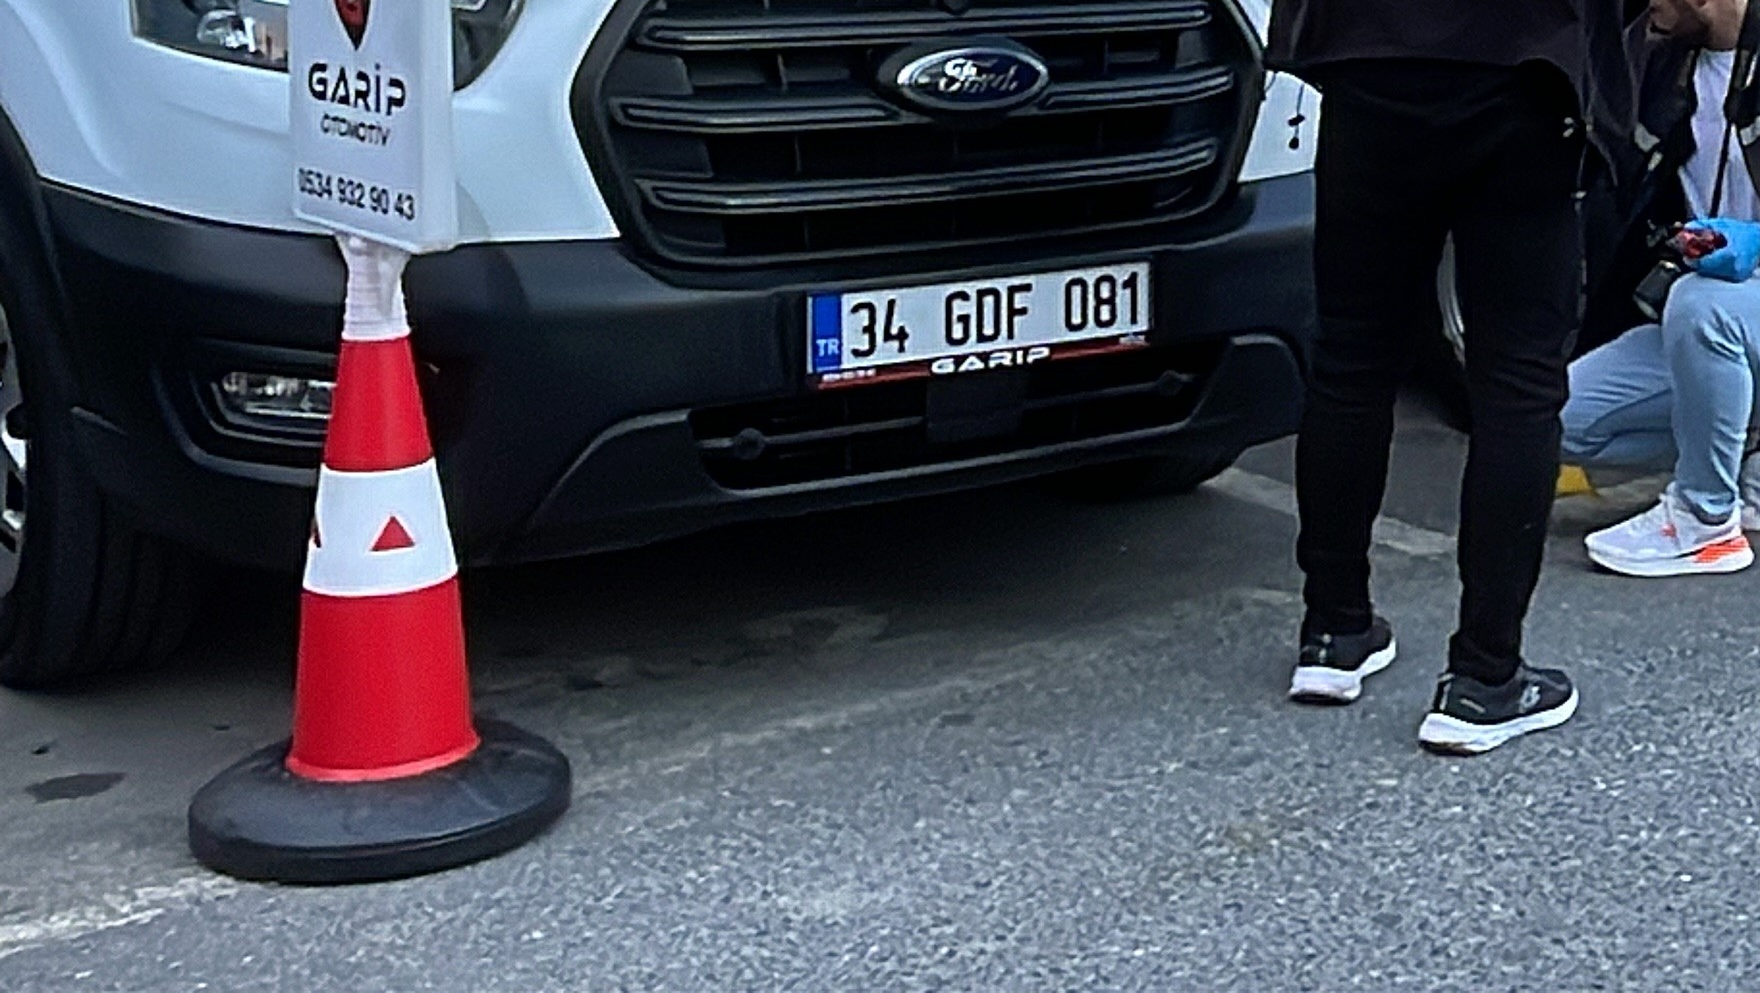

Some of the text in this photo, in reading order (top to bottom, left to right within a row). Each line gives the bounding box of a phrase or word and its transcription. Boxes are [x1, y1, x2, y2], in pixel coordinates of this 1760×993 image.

[938, 57, 1020, 94] Ford
[298, 167, 416, 222] 0534 932 90 43
[849, 270, 1140, 359] 34 GDF 081
[815, 339, 840, 357] TR
